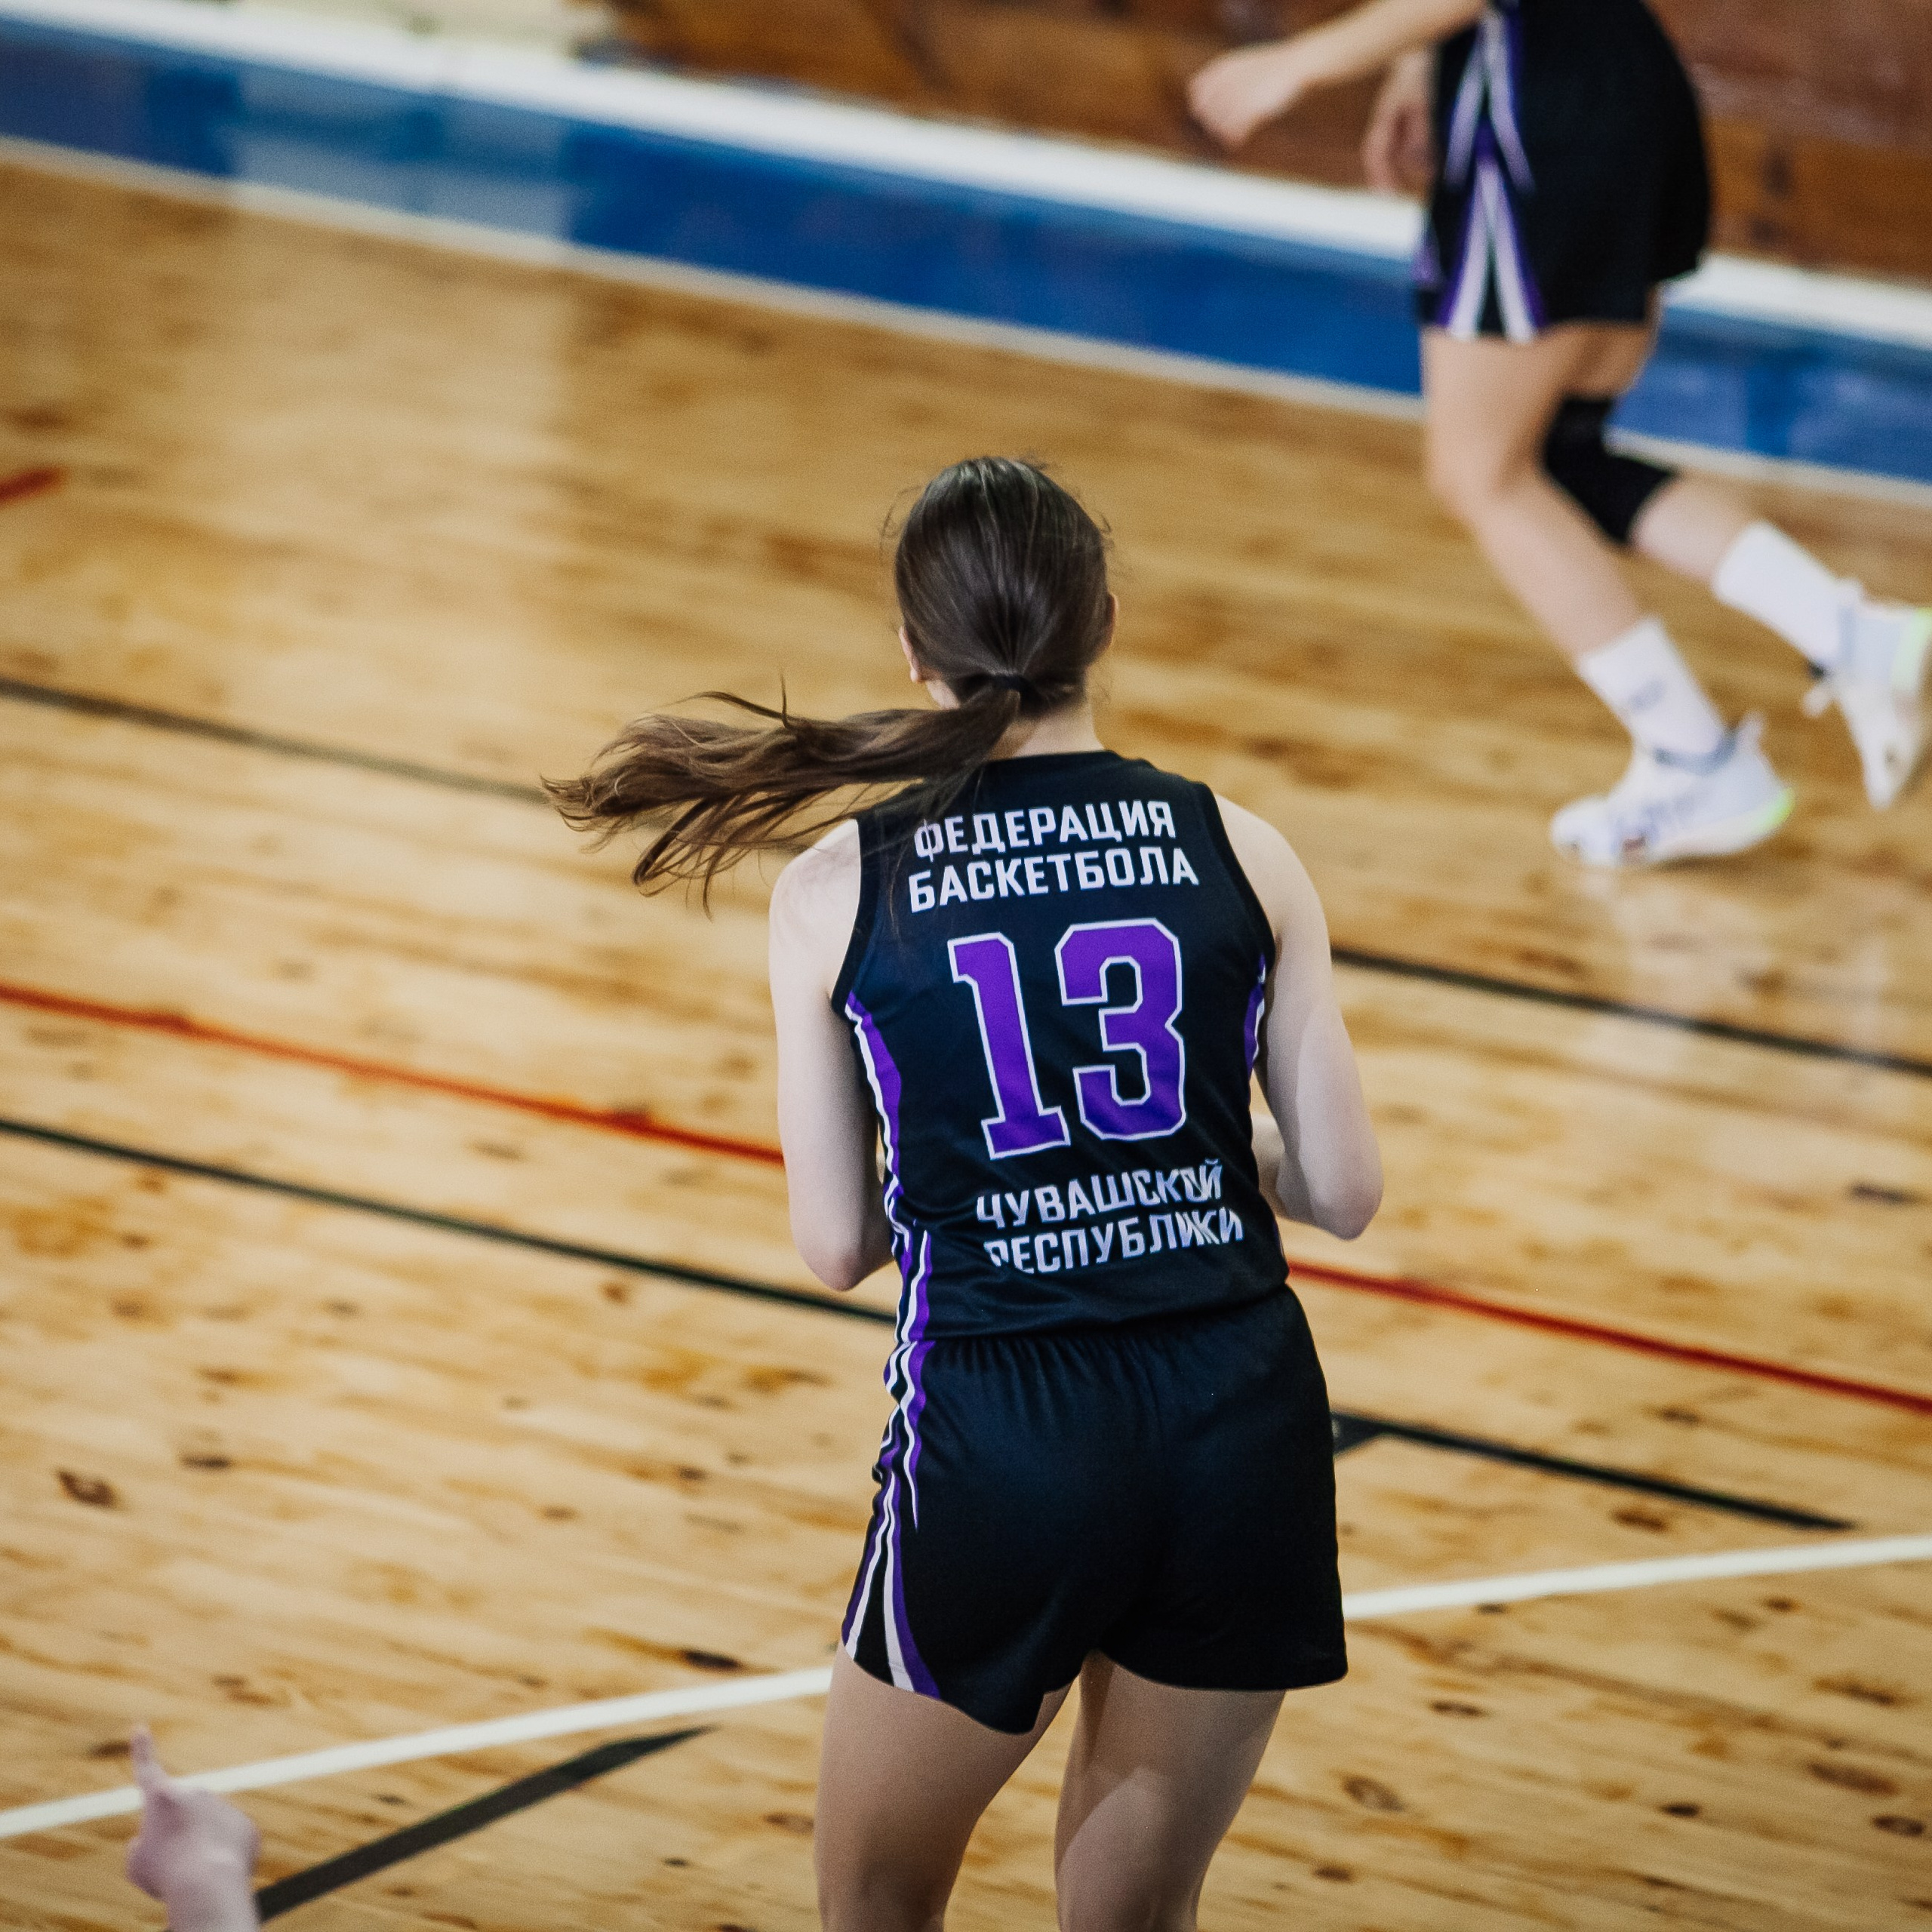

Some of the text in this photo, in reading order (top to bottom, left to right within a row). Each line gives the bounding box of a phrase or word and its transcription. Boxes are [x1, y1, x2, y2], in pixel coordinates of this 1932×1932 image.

[913, 800, 1177, 863] ФЕДЕРАЦИЯ
[909, 846, 1199, 913] БАСКЕТБОЛА
[947, 918, 1186, 1161] 13
